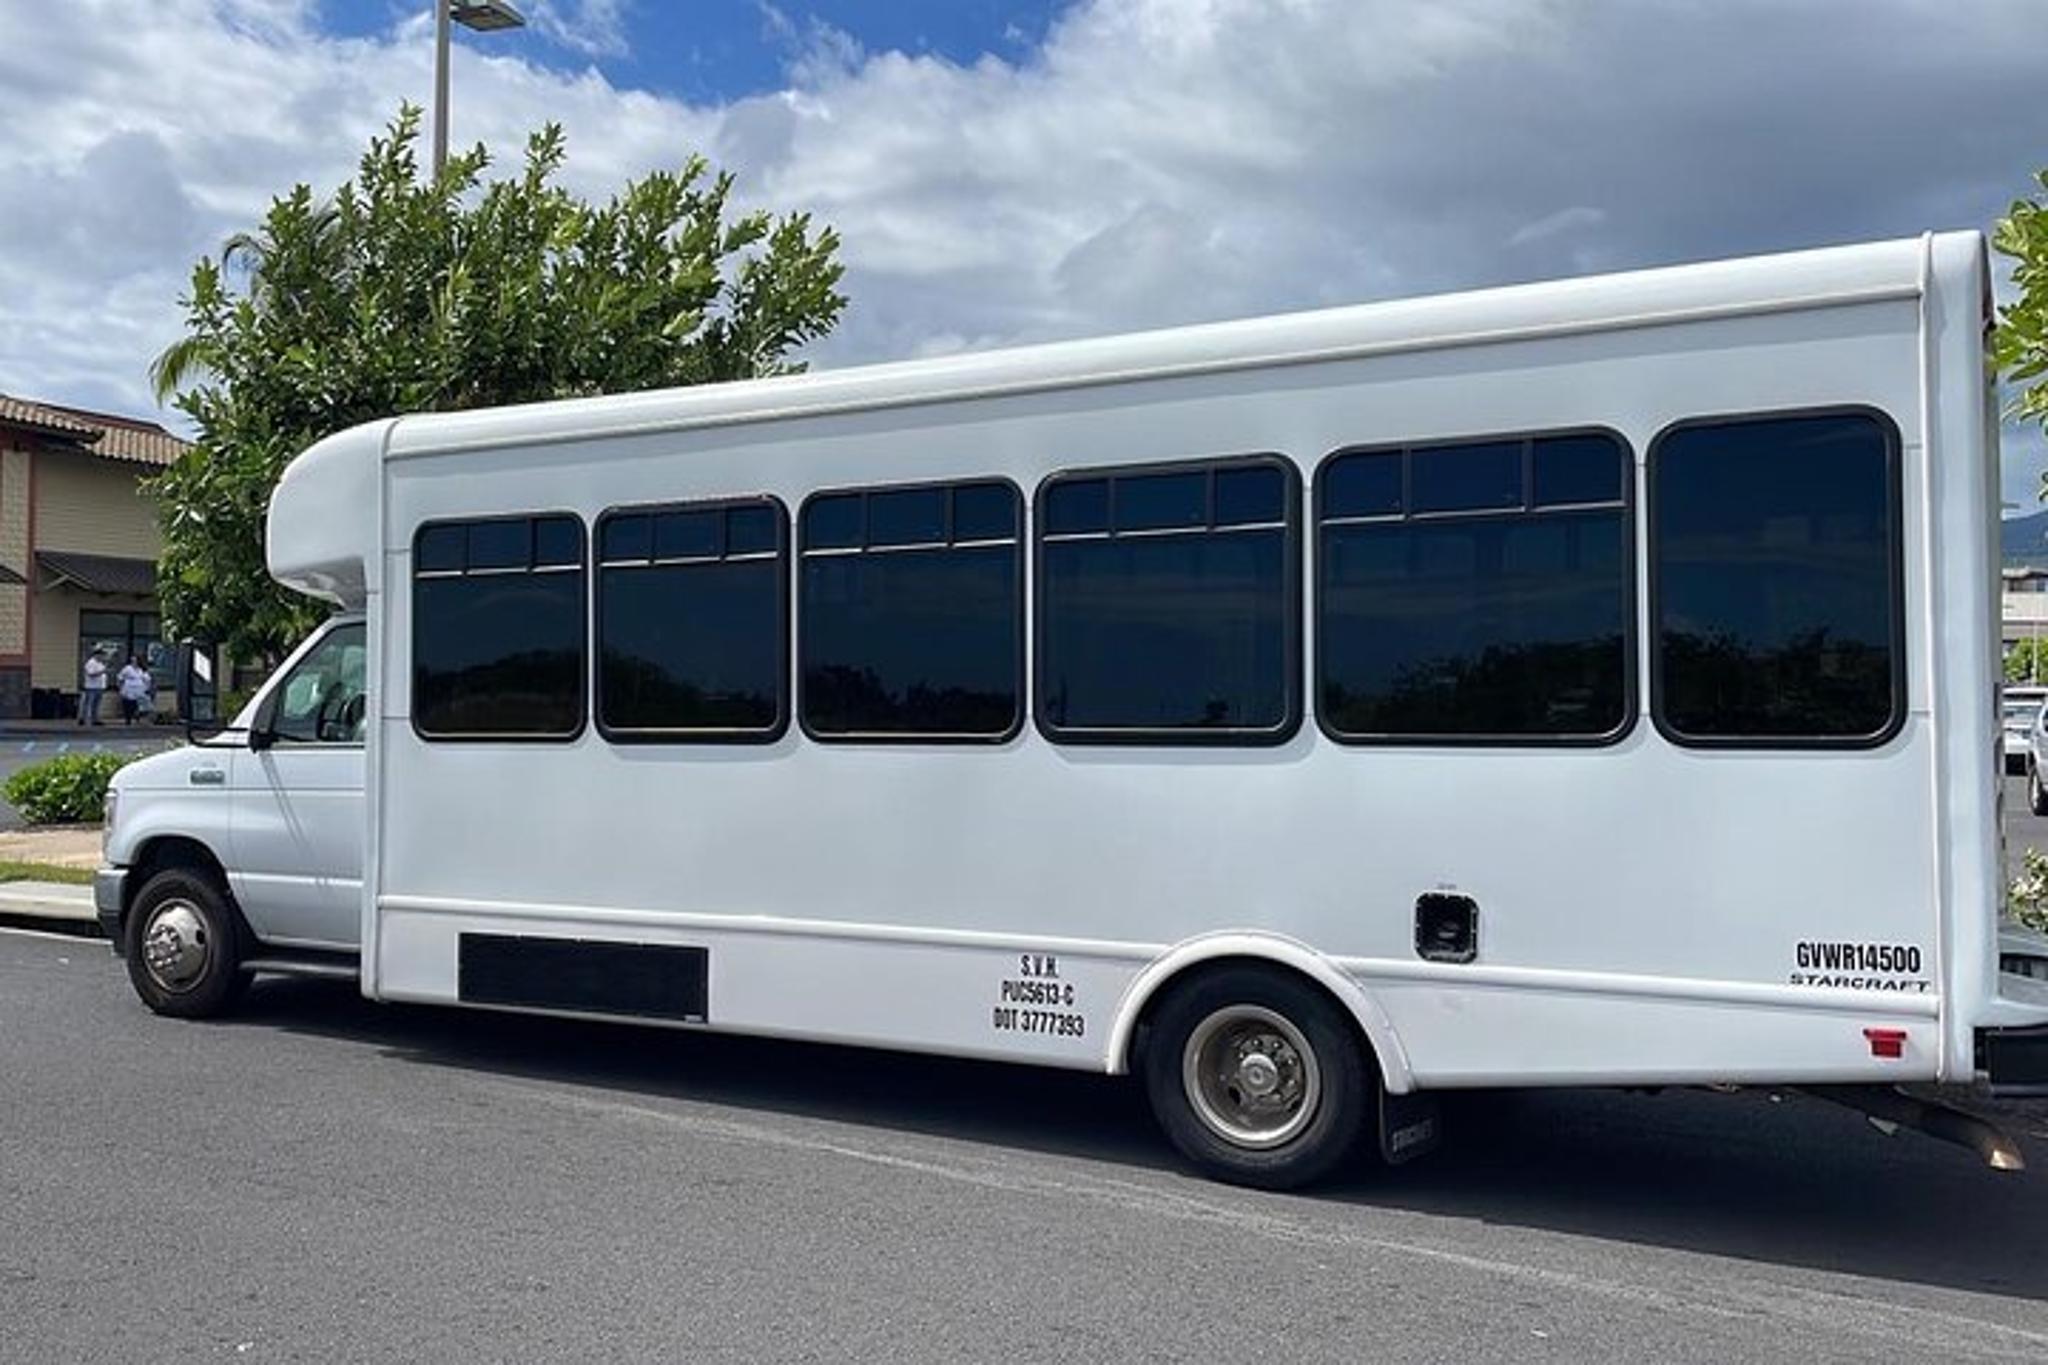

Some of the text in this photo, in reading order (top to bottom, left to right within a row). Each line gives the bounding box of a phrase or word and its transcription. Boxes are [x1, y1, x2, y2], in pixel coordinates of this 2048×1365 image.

[1797, 941, 1921, 973] GVWR14500
[1001, 980, 1074, 1006] PUC5613-C
[1789, 973, 1931, 993] STARCRAFT
[993, 1006, 1018, 1030] DOT
